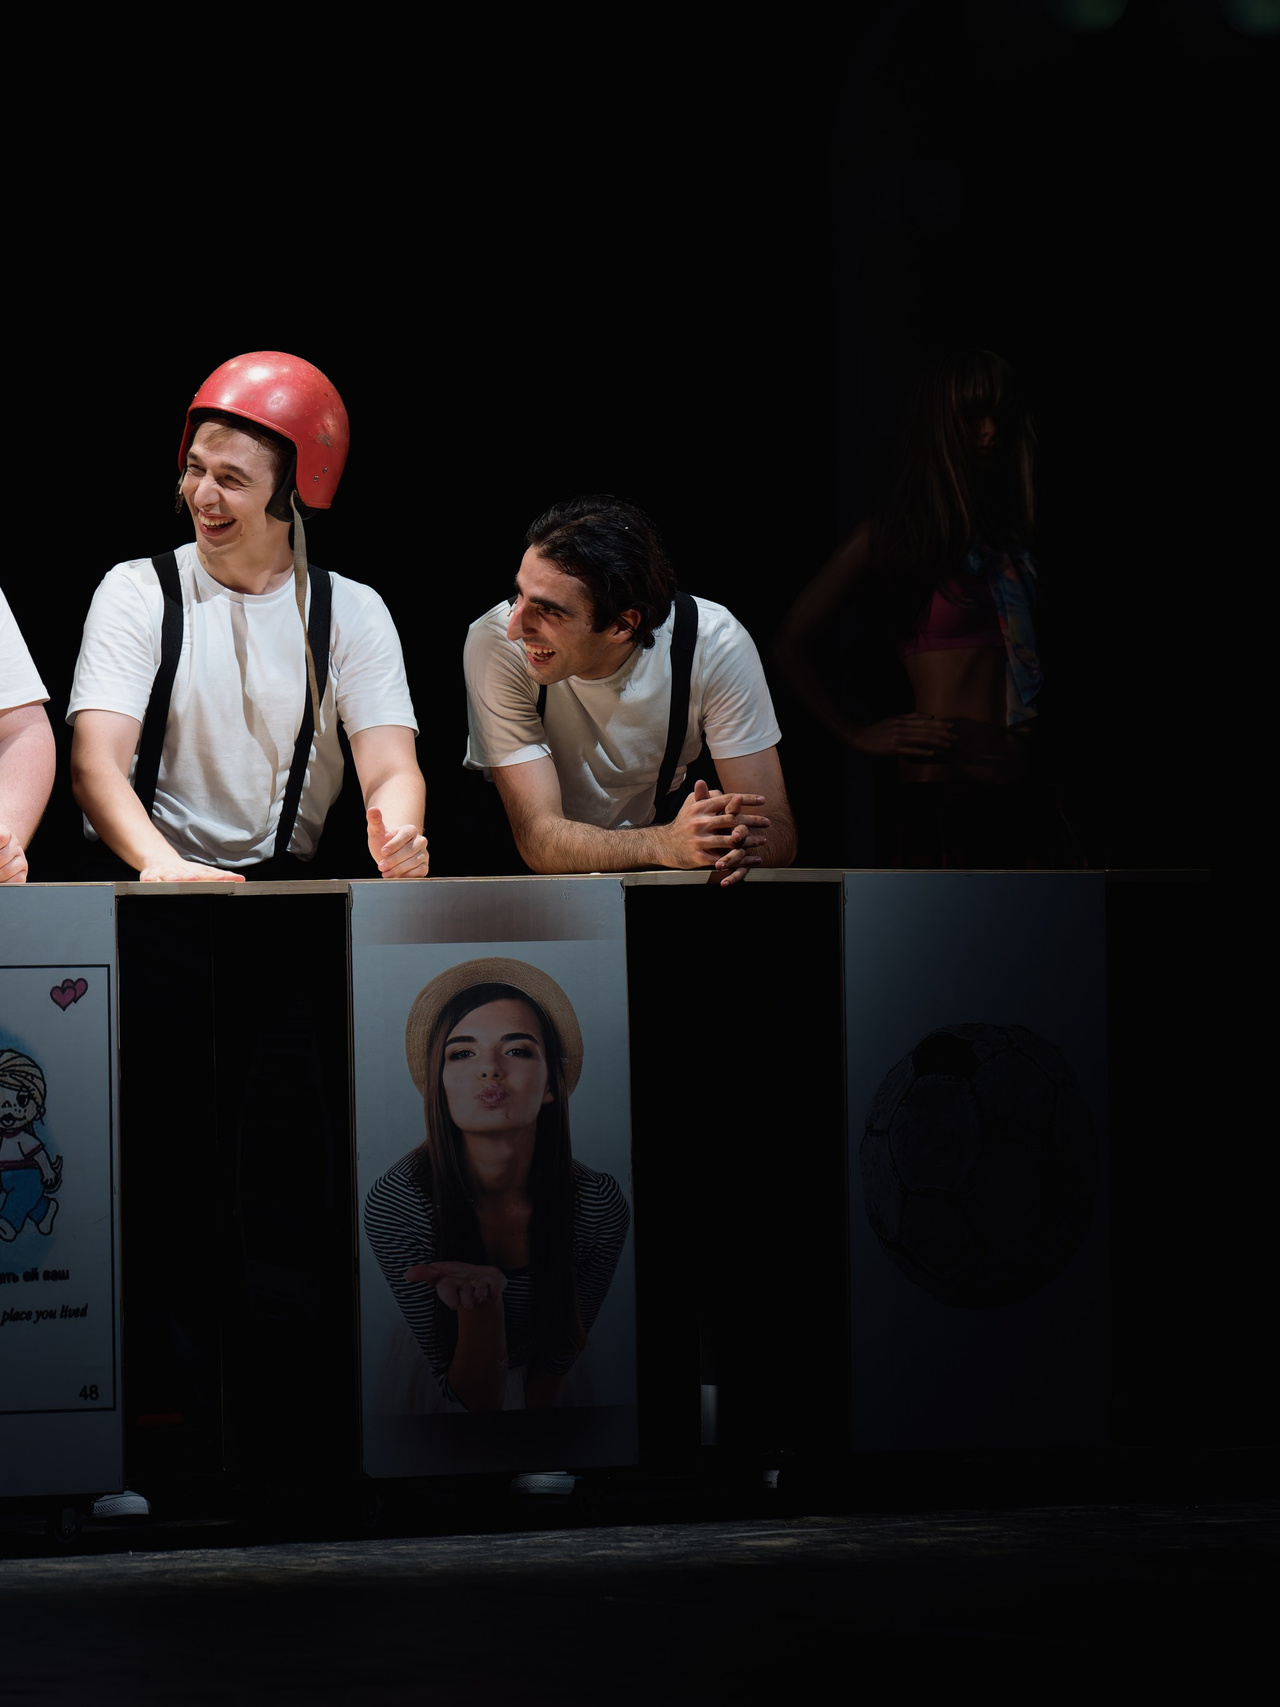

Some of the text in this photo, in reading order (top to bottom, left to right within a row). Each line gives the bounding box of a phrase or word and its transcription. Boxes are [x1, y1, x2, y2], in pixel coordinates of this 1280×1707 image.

[22, 1267, 40, 1283] ей
[43, 1269, 70, 1281] ваш
[0, 1307, 33, 1326] place
[33, 1309, 57, 1324] you
[60, 1303, 89, 1319] lived
[79, 1384, 100, 1401] 48
